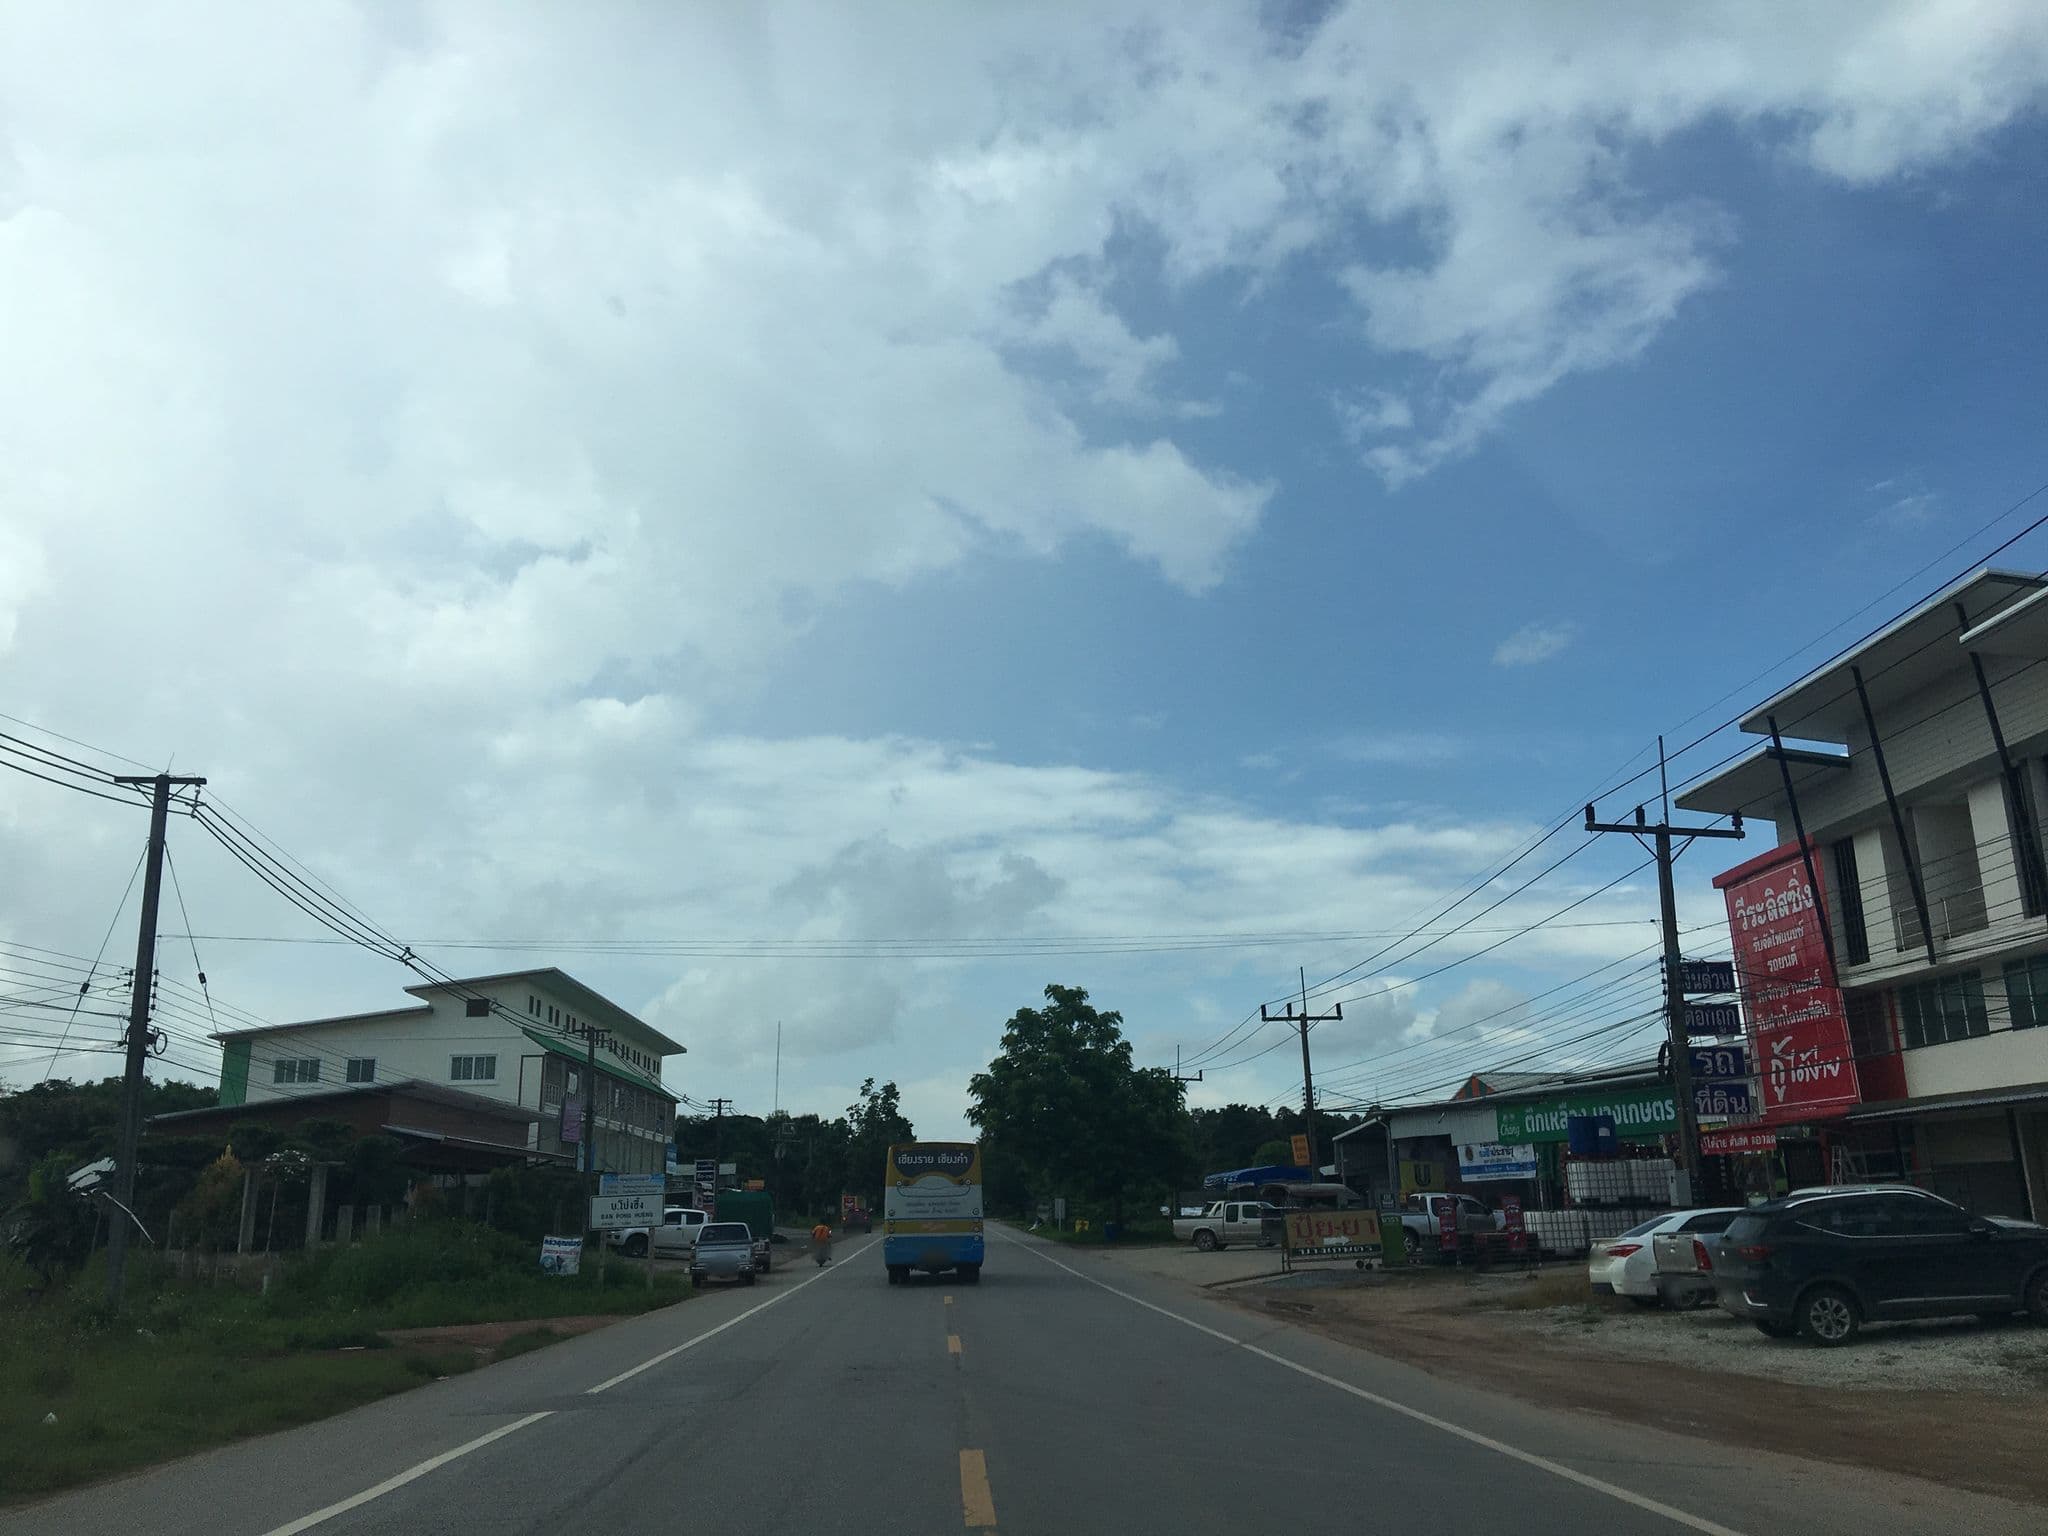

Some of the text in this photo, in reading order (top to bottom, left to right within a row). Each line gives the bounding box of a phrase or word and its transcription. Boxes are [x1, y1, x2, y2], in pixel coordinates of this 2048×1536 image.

[1766, 945, 1799, 972] รถยนต์
[1696, 1052, 1736, 1075] รถ
[1696, 1084, 1748, 1114] ที่ดิน
[898, 1153, 968, 1165] เชียงราย เชียงคำ
